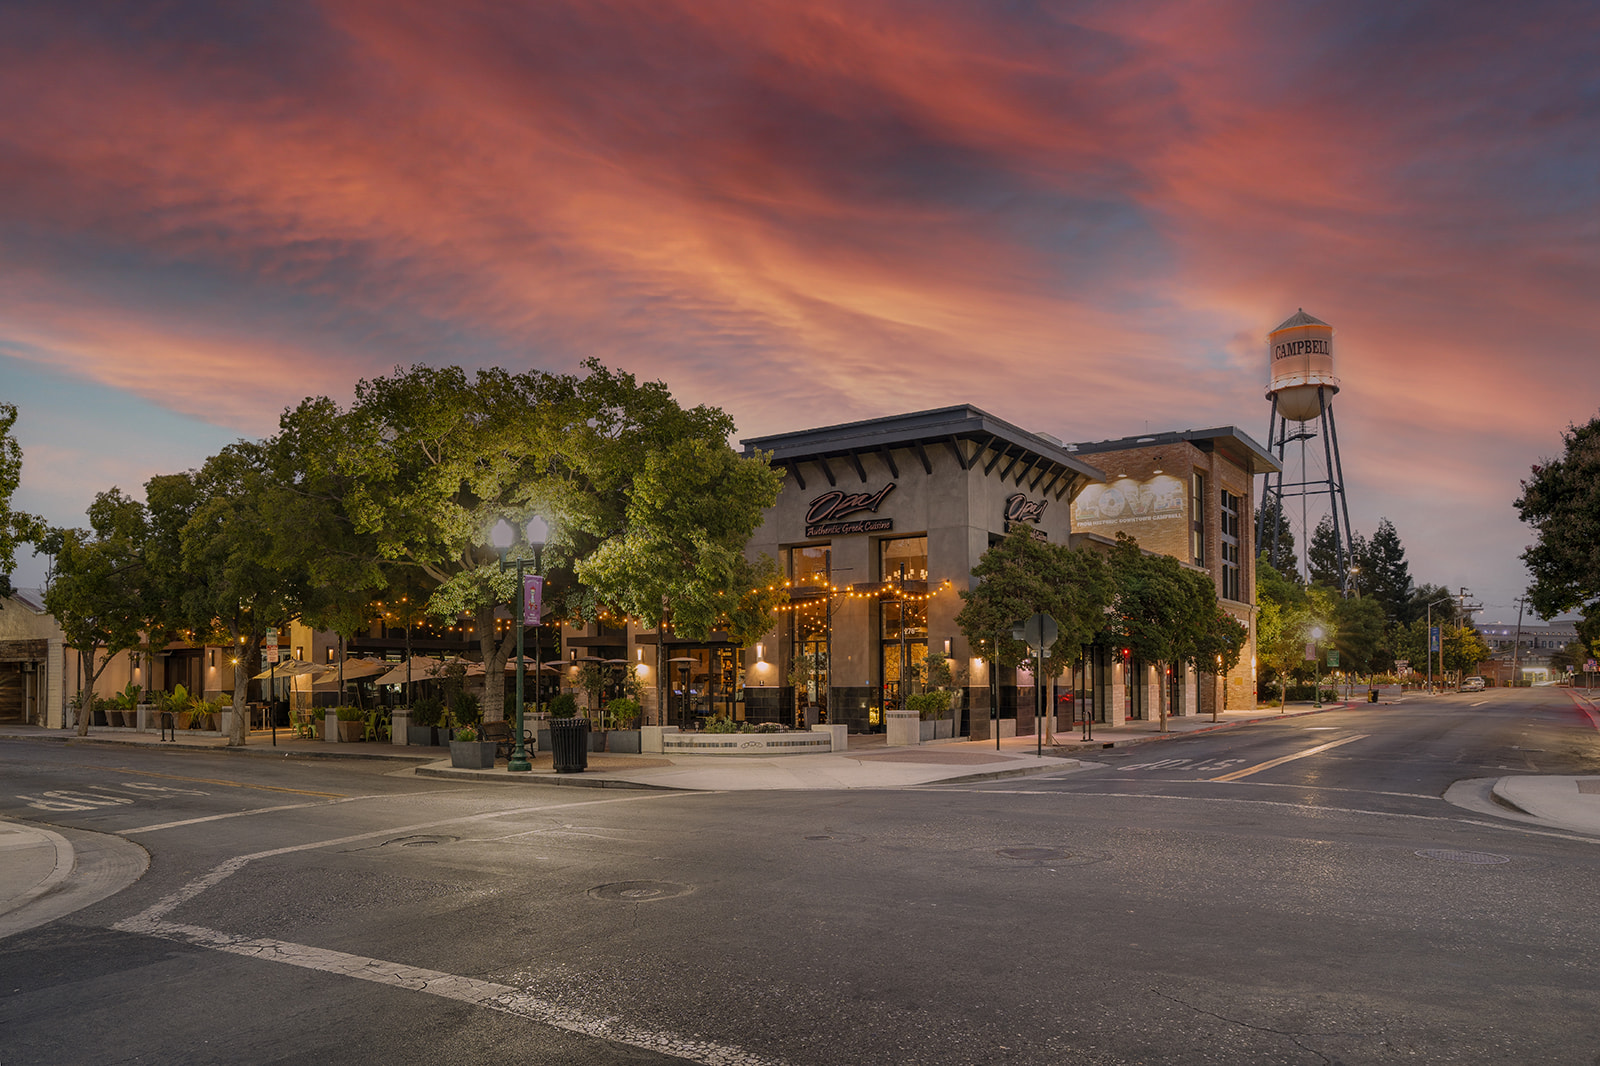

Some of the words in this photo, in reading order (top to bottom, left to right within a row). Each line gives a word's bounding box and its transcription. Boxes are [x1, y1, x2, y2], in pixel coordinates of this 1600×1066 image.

[1275, 339, 1330, 360] CAMPBELL
[807, 525, 840, 536] Authentic
[841, 521, 863, 534] Greek
[864, 521, 890, 531] Cuisine
